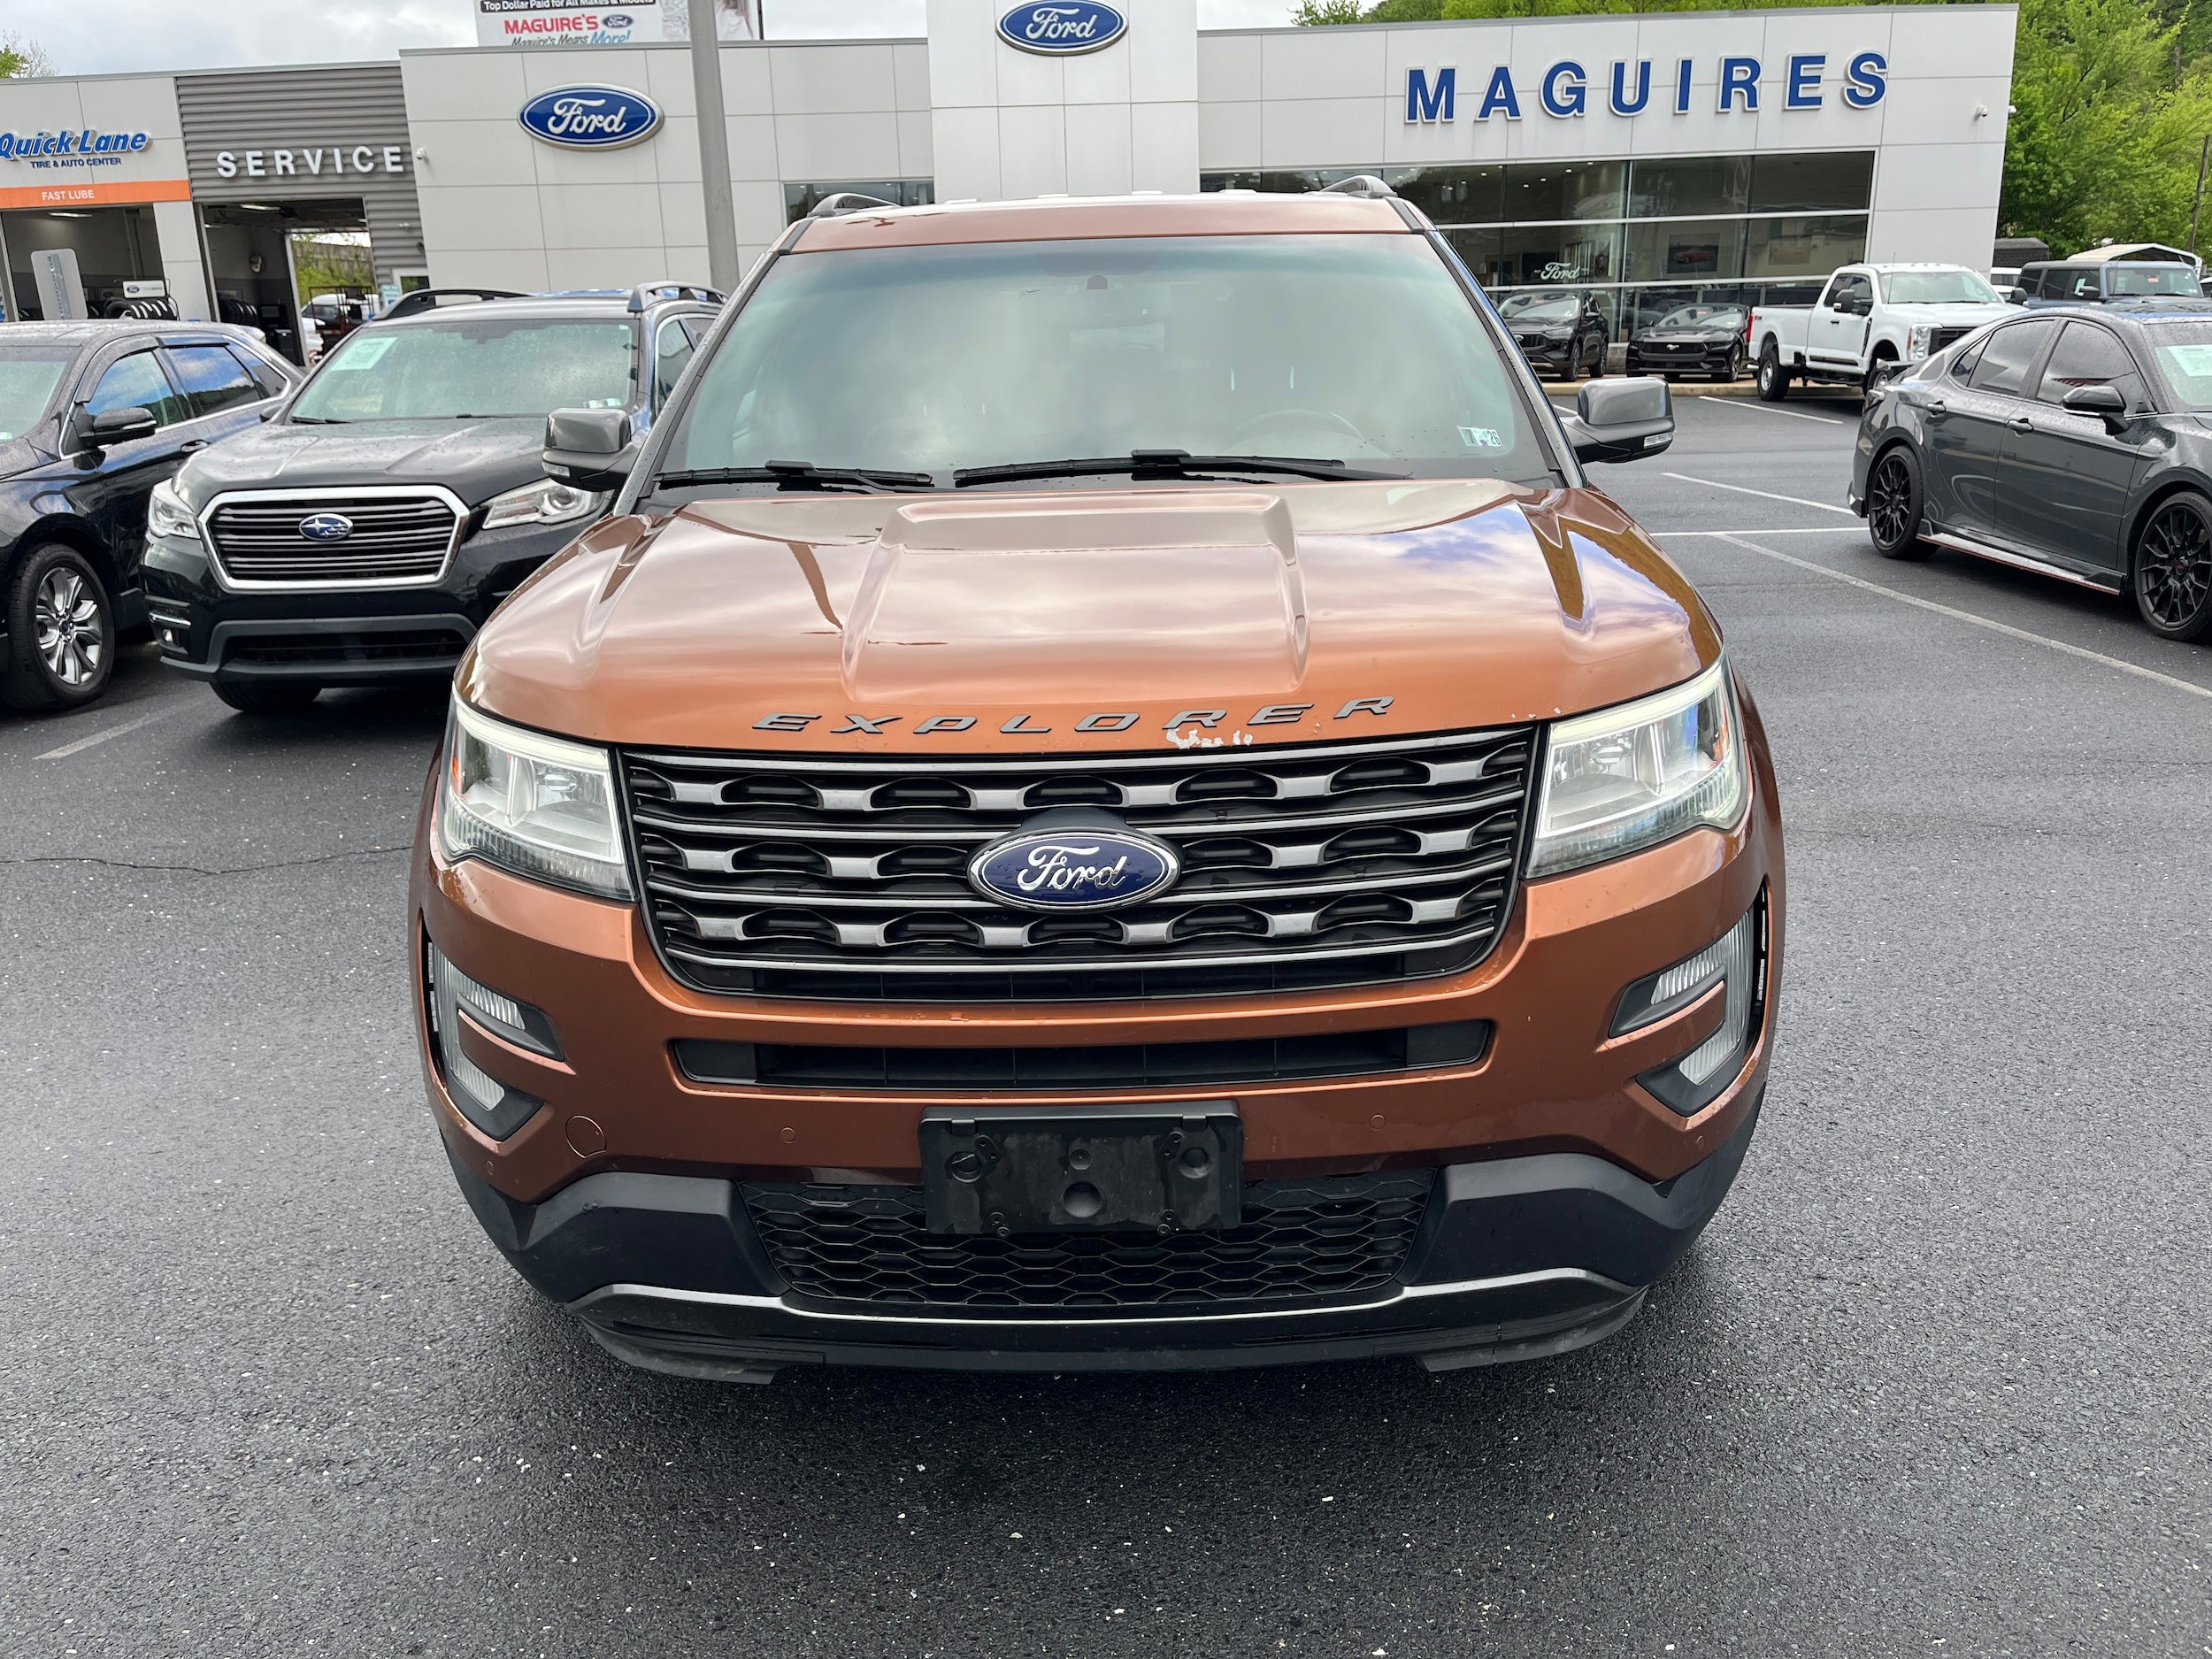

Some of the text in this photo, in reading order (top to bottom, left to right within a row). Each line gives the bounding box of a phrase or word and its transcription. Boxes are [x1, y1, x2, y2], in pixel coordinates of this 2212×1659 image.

[484, 2, 501, 12] Top
[502, 0, 528, 10] Dollar
[503, 14, 599, 34] MAGUIRE'S
[1025, 7, 1098, 40] Ford
[557, 34, 589, 45] Means
[590, 30, 631, 44] More!
[1405, 50, 1889, 123] MAGUIRES
[548, 97, 627, 134] Ford
[0, 129, 148, 160] Quick Lane
[30, 157, 122, 169] TIRE & AUTO CENTER
[217, 145, 404, 178] SERVICE
[42, 188, 95, 201] FAST LUBE
[1540, 262, 1580, 280] Ford
[1487, 430, 1502, 445] 26
[752, 695, 1395, 734] EXPLORER
[1017, 845, 1128, 892] Ford
